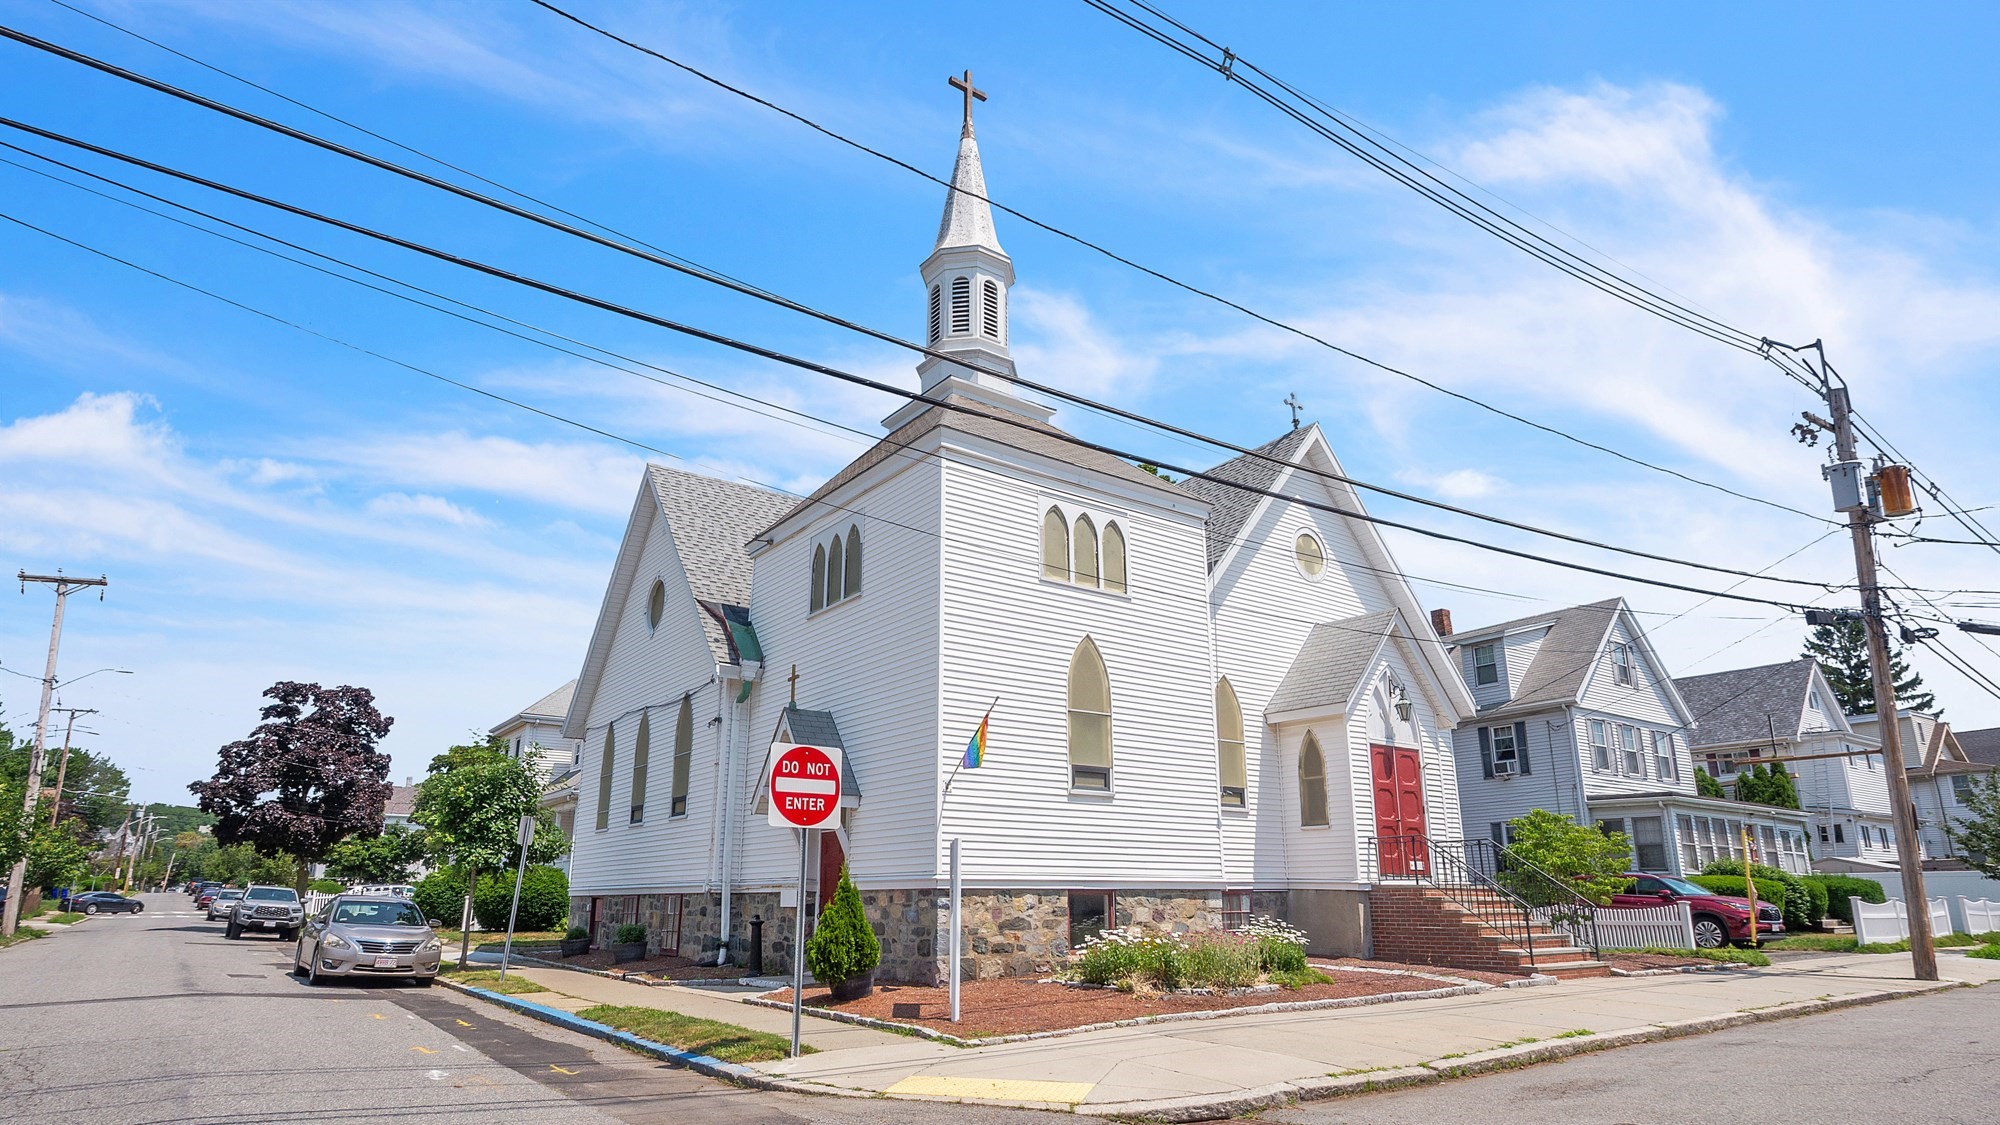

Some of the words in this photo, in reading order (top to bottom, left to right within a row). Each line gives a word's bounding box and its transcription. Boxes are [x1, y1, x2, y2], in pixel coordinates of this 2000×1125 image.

[782, 760, 799, 774] DO
[807, 762, 831, 776] NOT
[785, 796, 825, 812] ENTER
